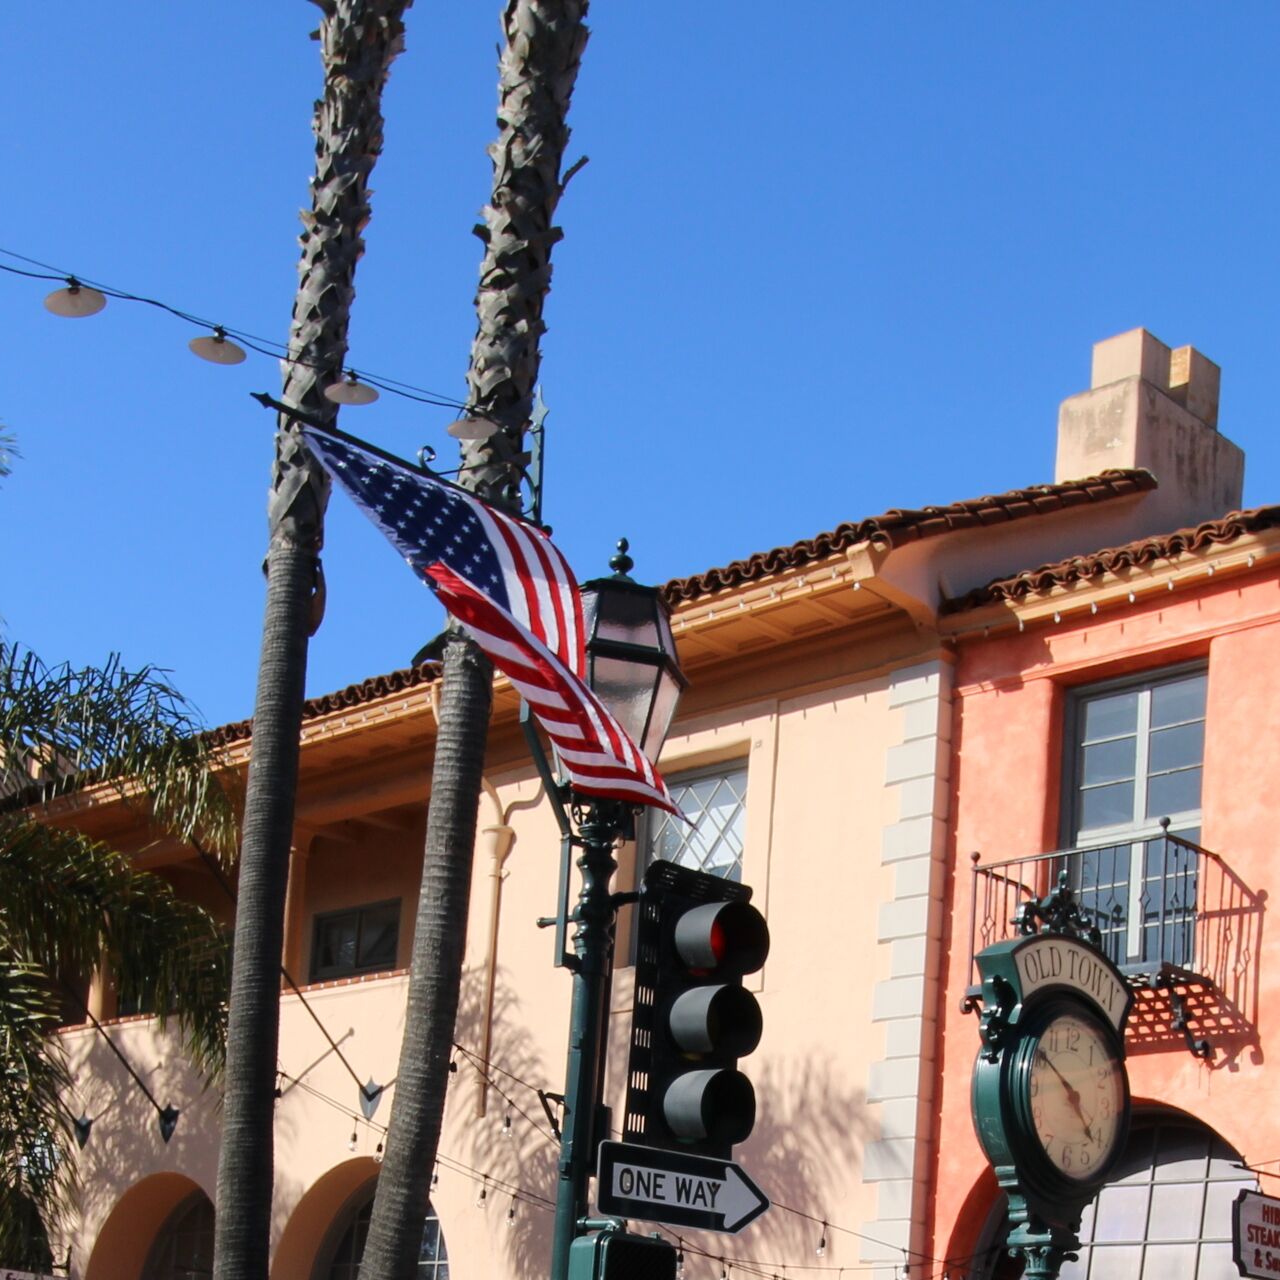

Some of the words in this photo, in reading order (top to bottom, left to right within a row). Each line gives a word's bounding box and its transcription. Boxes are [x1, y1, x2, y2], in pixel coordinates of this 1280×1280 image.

[1024, 946, 1062, 984] OLD
[1067, 949, 1120, 1012] TOWN
[1065, 1027, 1081, 1052] 12
[1097, 1068, 1108, 1090] 2
[1100, 1097, 1110, 1121] 3
[619, 1167, 666, 1200] ONE
[675, 1176, 722, 1208] WAY
[1247, 1223, 1280, 1250] STEAK
[1254, 1248, 1263, 1269] &
